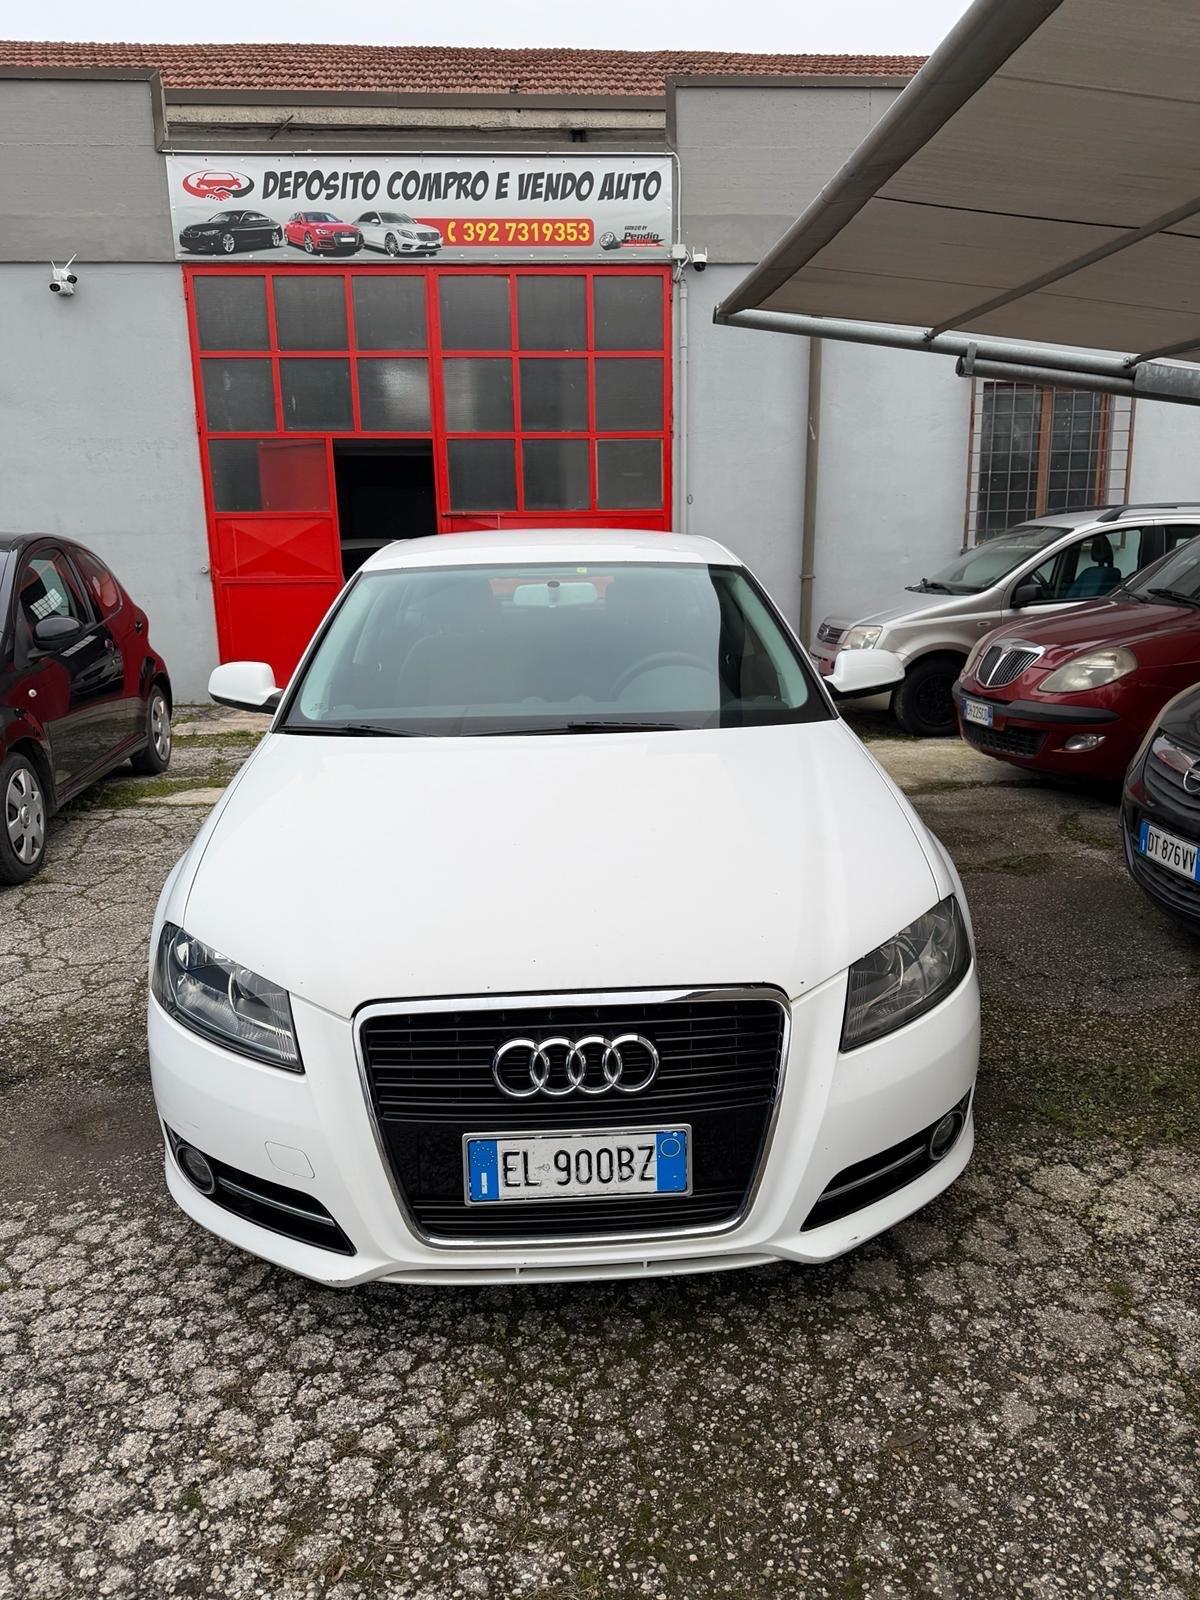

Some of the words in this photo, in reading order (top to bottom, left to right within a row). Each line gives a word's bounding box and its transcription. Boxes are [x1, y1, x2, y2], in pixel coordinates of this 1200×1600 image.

[262, 170, 381, 201] DEPOSITO
[387, 170, 489, 202] COMPRO
[495, 171, 510, 200] E
[518, 170, 595, 202] VENDO
[597, 170, 662, 201] AUTO
[463, 222, 500, 242] 392
[504, 222, 590, 242] 7319353
[624, 232, 659, 240] Pendin
[1148, 832, 1160, 855] DT
[1161, 840, 1196, 873] 876VV
[502, 1150, 542, 1188] EL
[553, 1144, 656, 1187] 900BZ
